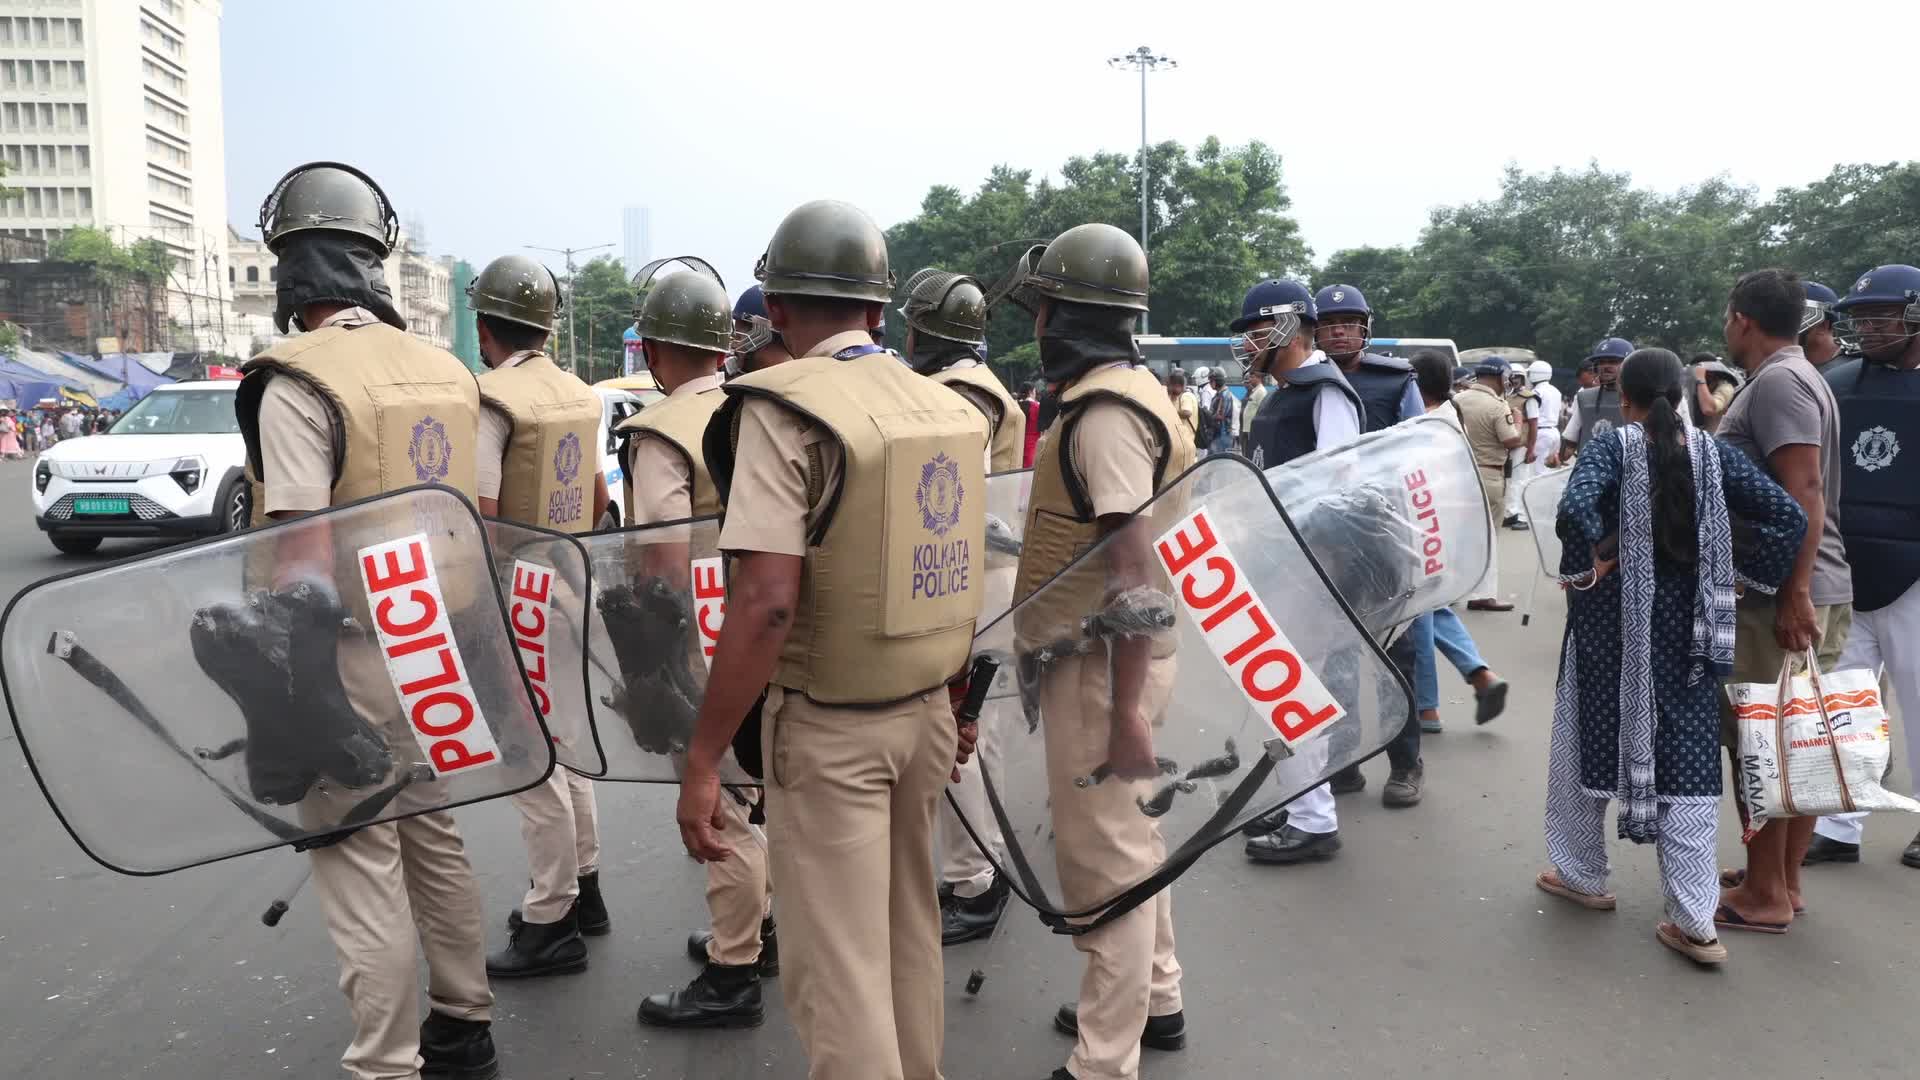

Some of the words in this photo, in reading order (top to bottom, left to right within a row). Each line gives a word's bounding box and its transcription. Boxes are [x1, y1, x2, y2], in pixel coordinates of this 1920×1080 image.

[548, 503, 582, 524] POLICE
[549, 487, 583, 508] KOLKATA
[1404, 469, 1443, 576] POLICE
[912, 539, 969, 571] KOLKATA
[912, 566, 969, 600] POLICE
[363, 541, 496, 773] POLICE
[511, 567, 553, 720] OLICE
[1158, 512, 1338, 743] POLICE
